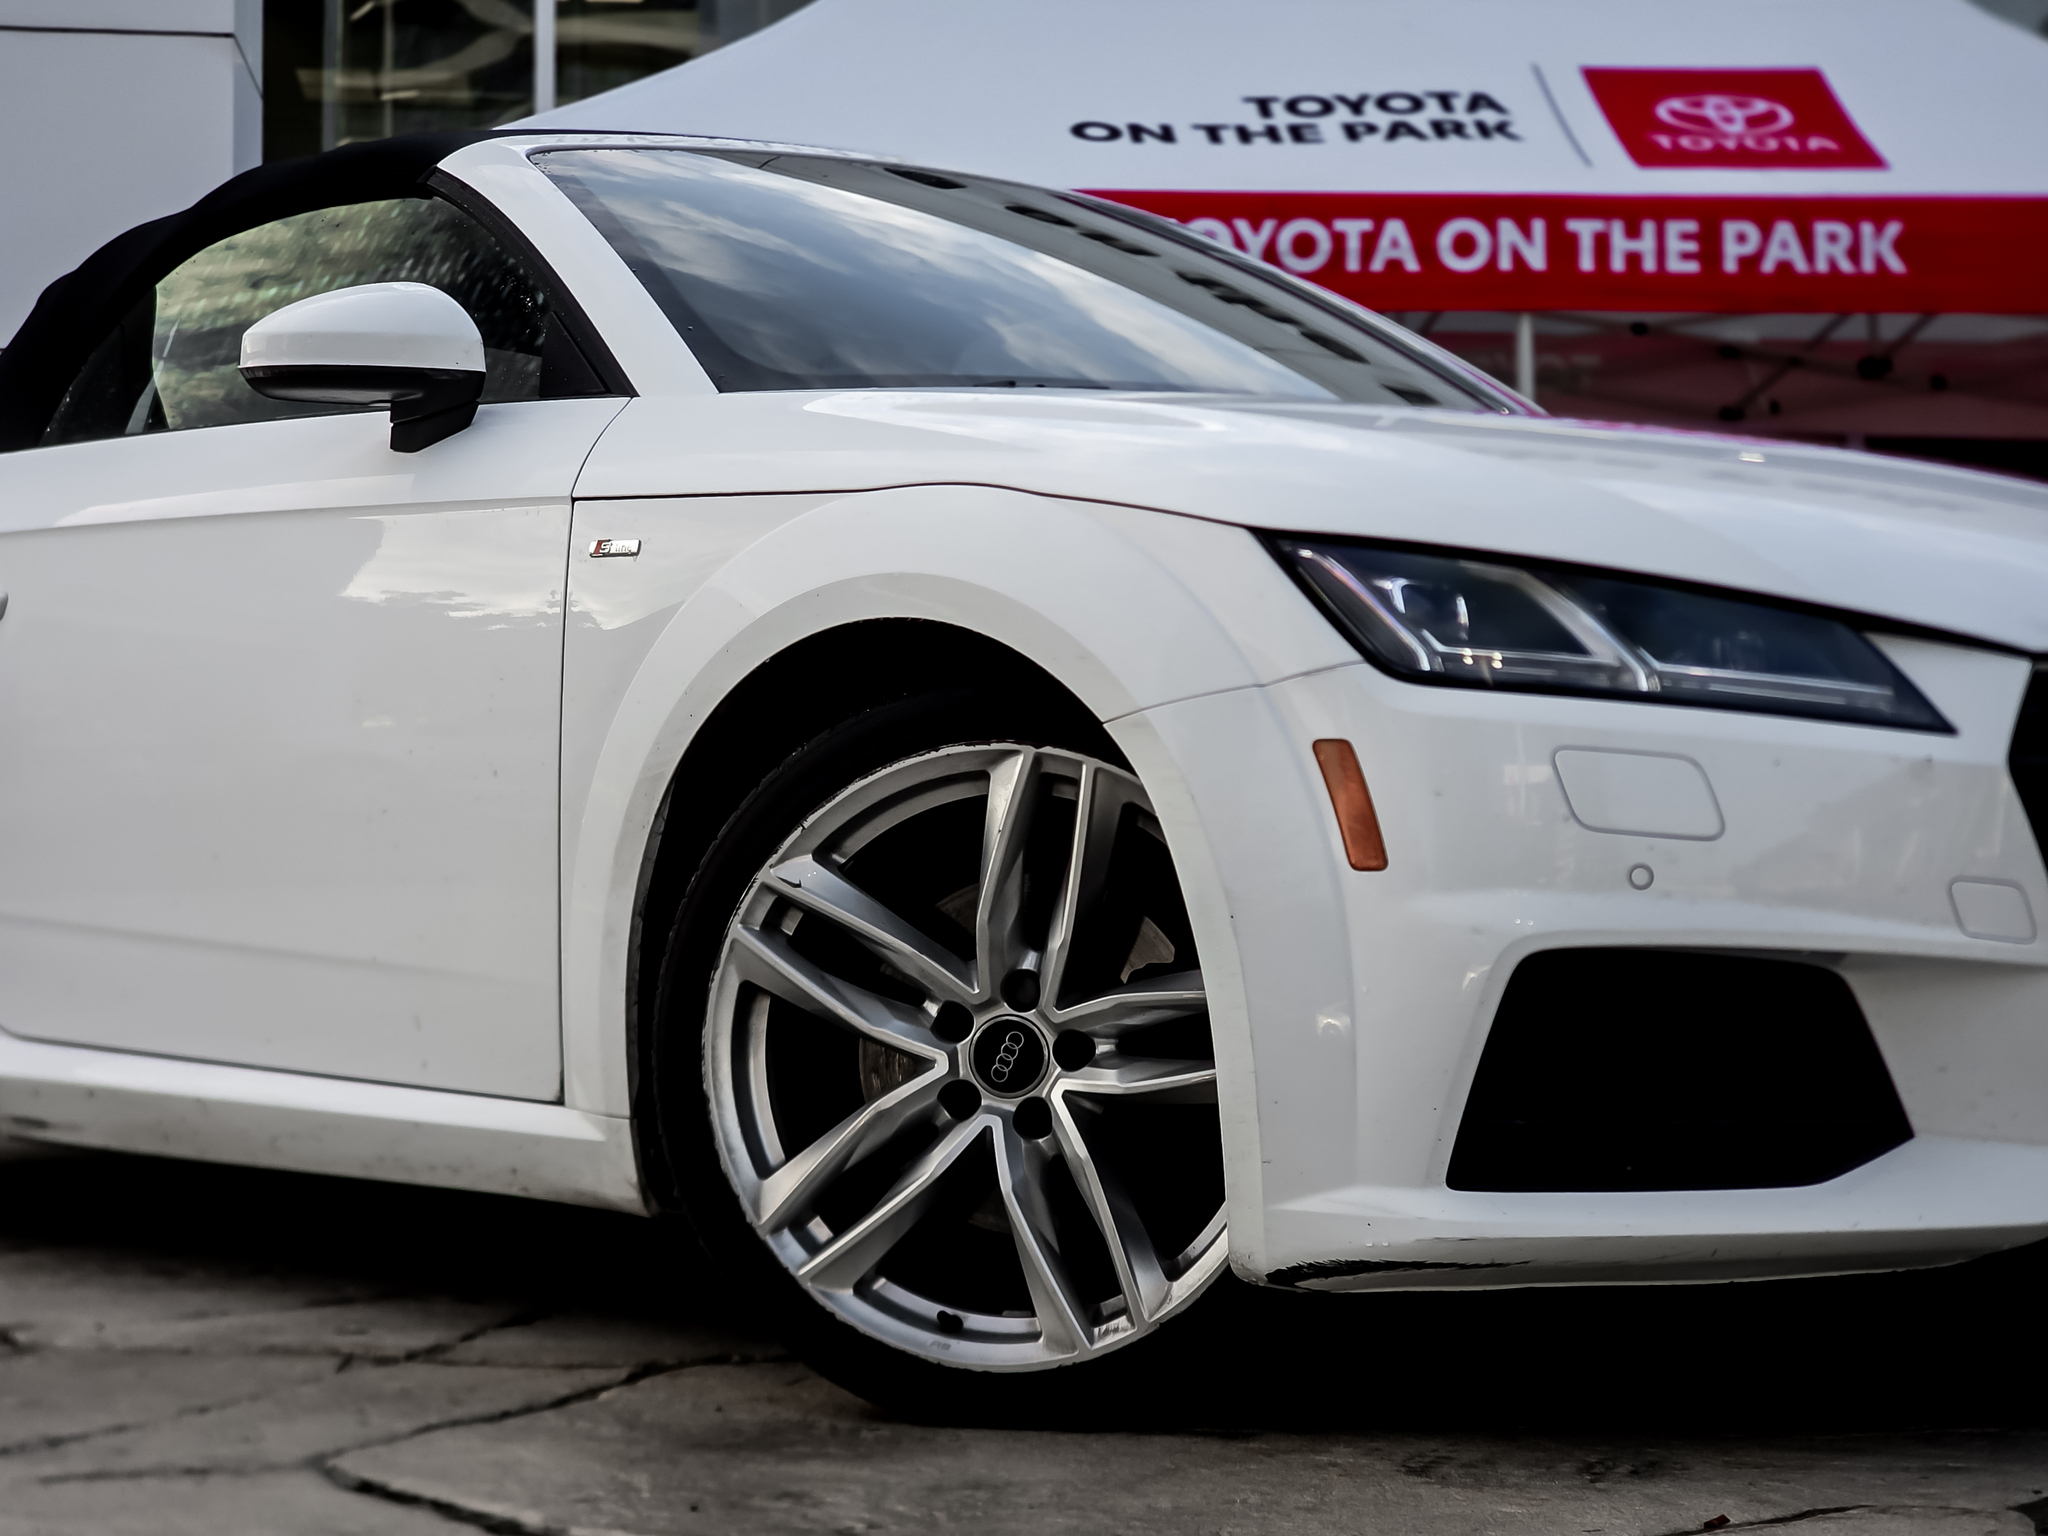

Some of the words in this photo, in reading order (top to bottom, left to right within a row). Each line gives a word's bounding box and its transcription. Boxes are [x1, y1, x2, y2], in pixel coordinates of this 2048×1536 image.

[1242, 90, 1509, 119] TOYOTA
[1069, 120, 1177, 144] ON
[1191, 122, 1325, 145] THE
[1340, 119, 1523, 143] PARK
[1435, 216, 1548, 273] ON
[1564, 217, 1701, 274] THE
[1721, 219, 1907, 275] PARK
